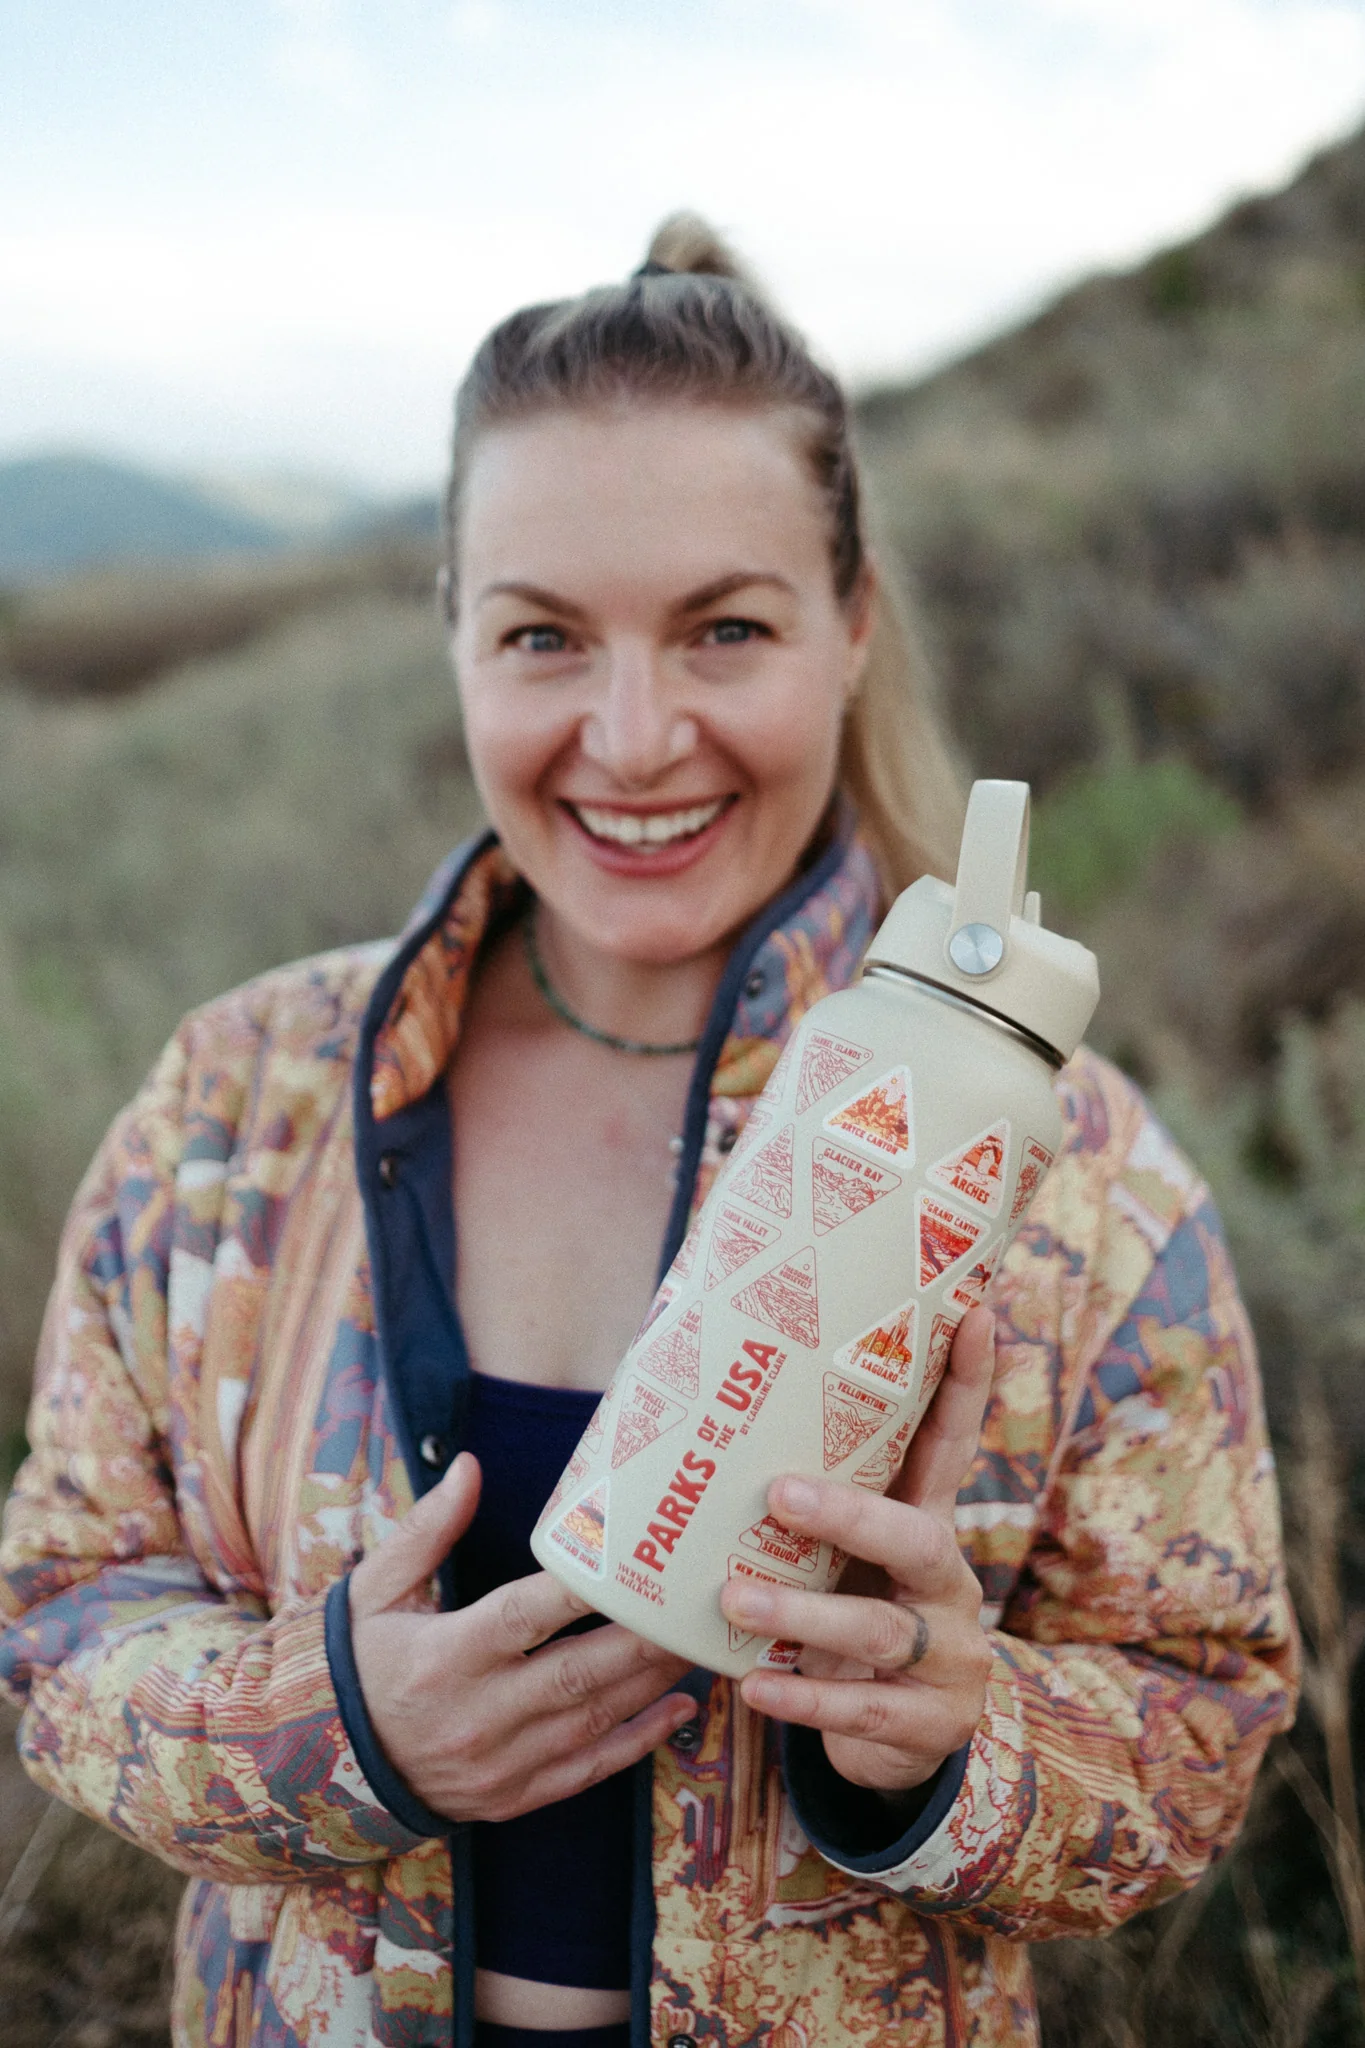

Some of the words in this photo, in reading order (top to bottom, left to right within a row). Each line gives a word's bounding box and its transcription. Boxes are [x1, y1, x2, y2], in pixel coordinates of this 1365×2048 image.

[834, 1041, 862, 1060] ISLANDS
[840, 1121, 865, 1139] BRYCE
[866, 1132, 899, 1156] CANYON
[823, 1148, 862, 1174] GLACIER
[864, 1167, 884, 1184] BAY
[950, 1175, 990, 1204] ARCHES
[742, 1218, 768, 1238] VALLEY
[927, 1204, 954, 1223] GRAND
[954, 1217, 980, 1237] CANYON
[716, 1338, 779, 1412] USA
[859, 1359, 899, 1384] SAGUARO
[739, 1421, 750, 1436] BY
[749, 1382, 772, 1423] CAROLINE
[768, 1353, 788, 1380] CLARK
[836, 1382, 888, 1412] YELLOWSTONE
[696, 1414, 720, 1442] OF
[714, 1424, 736, 1451] THE
[633, 1450, 716, 1573] PARKS
[761, 1540, 801, 1565] SEQUOIA
[735, 1562, 754, 1576] NEW
[615, 1572, 665, 1606] outdoors
